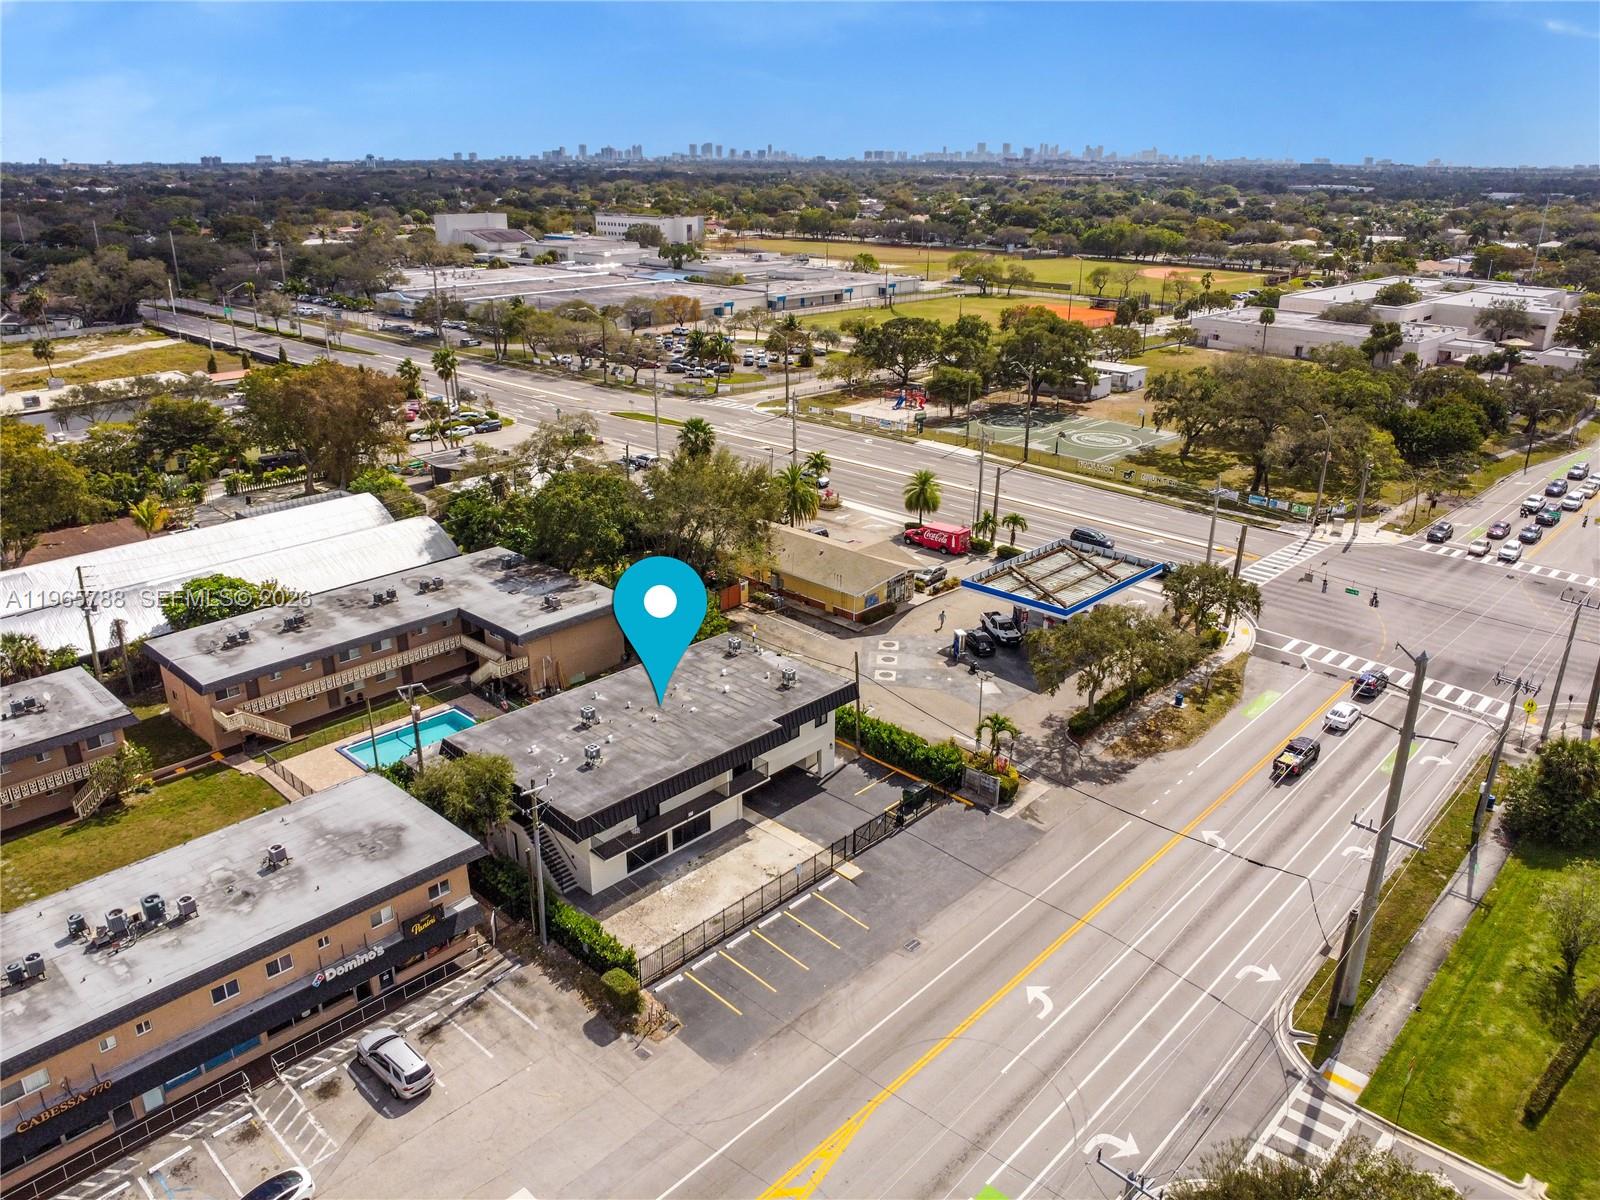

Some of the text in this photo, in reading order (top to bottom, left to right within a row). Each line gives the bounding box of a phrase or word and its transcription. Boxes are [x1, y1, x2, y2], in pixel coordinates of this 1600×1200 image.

[324, 945, 385, 982] Domino's
[16, 1079, 112, 1134] CABESSA 770
